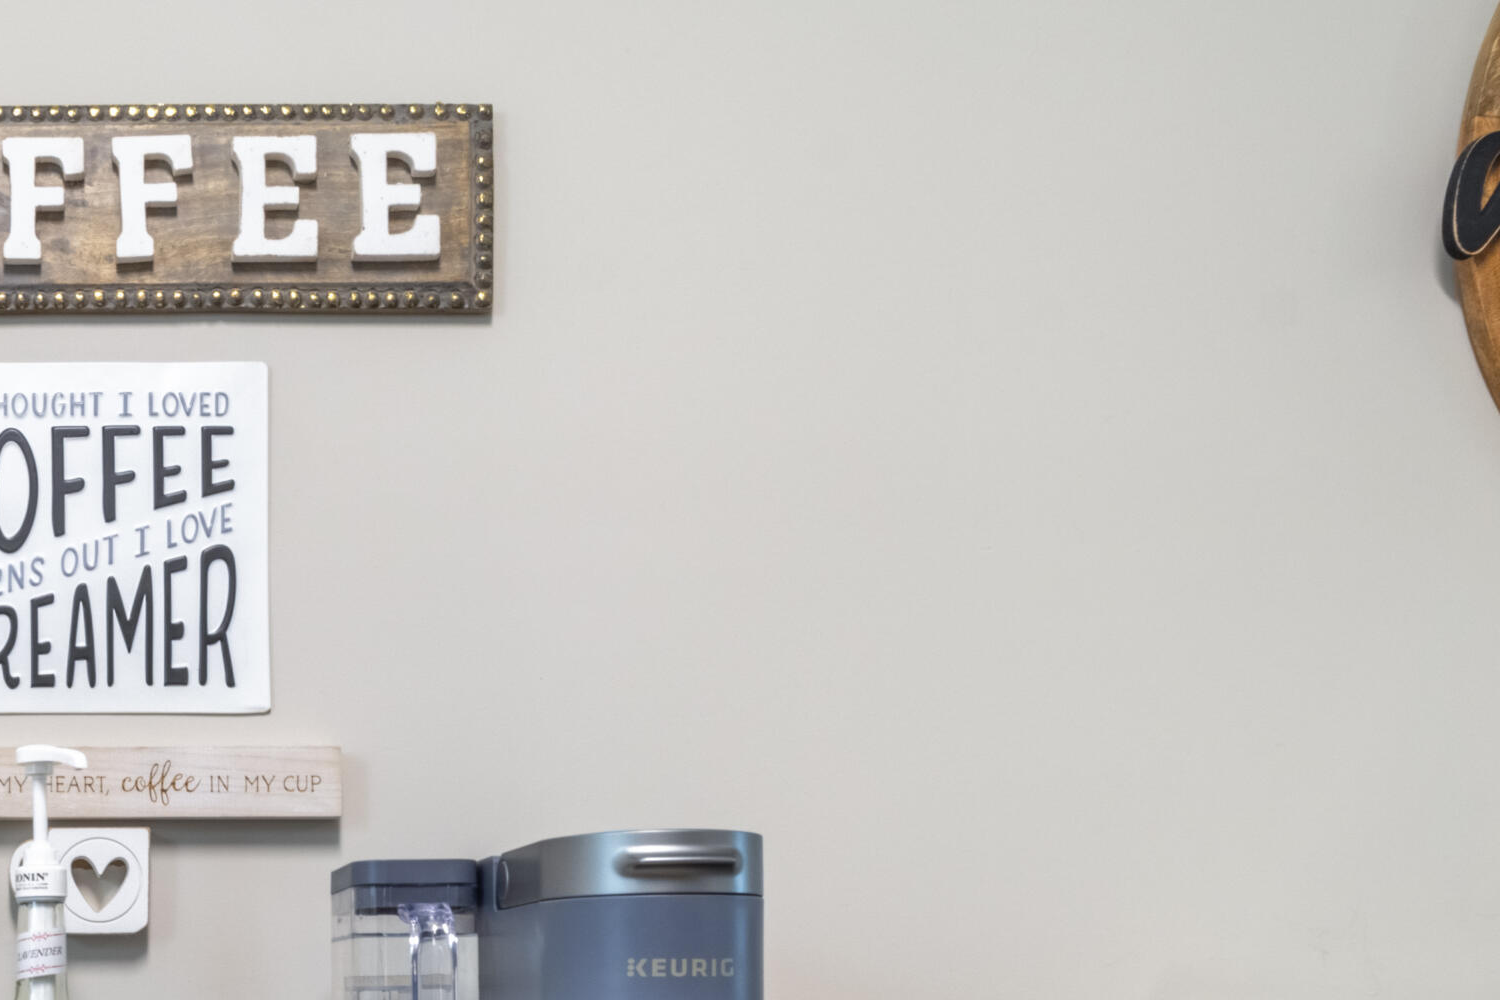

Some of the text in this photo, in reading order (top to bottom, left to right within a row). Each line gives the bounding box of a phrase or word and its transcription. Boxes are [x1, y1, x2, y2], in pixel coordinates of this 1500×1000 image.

[119, 392, 133, 417] I
[148, 391, 231, 417] LOVED
[60, 533, 120, 578] OUT
[134, 525, 151, 558] I
[166, 502, 234, 549] LOVE
[121, 760, 201, 807] coffee
[209, 775, 230, 793] IN
[244, 775, 276, 793] MY
[283, 775, 322, 793] CUP
[627, 957, 735, 977] KEURIG
